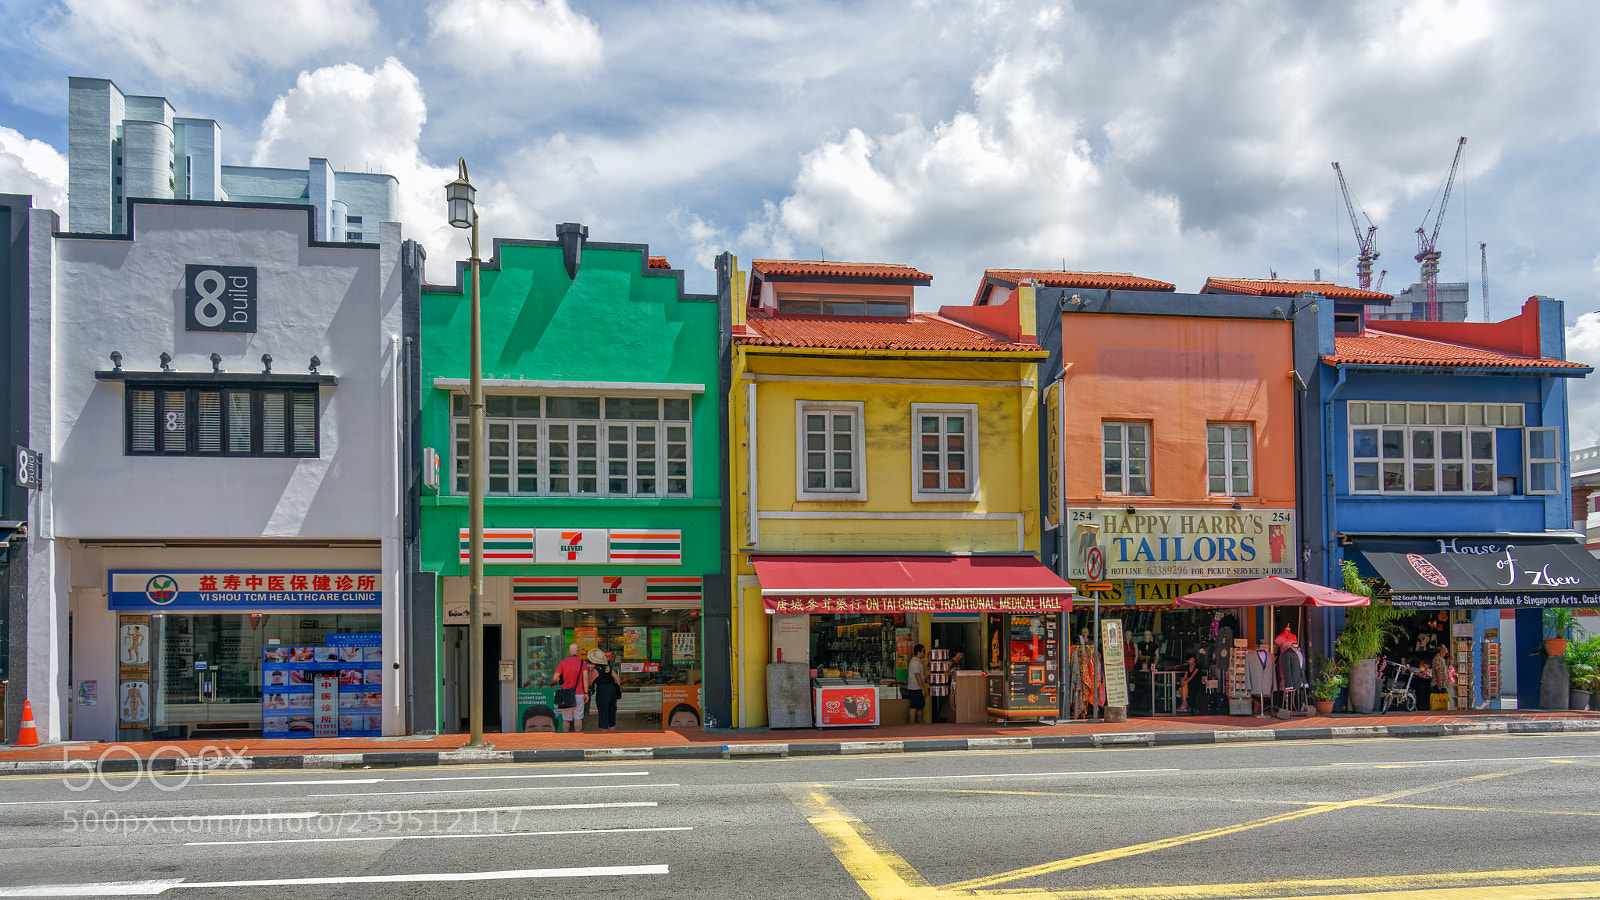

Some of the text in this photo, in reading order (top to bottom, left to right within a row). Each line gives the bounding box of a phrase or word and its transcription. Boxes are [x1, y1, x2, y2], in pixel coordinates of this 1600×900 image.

[195, 270, 248, 327] 8 build
[20, 450, 28, 484] 8
[1049, 408, 1058, 515] TAILORS
[1073, 512, 1092, 521] 254
[1103, 514, 1263, 535] HAPPY HARRY'S
[1272, 512, 1290, 522] 254
[561, 532, 582, 560] 7
[1113, 536, 1256, 562] TAILORS
[1436, 538, 1500, 555] House
[1111, 567, 1142, 575] HOTLINE
[1147, 566, 1188, 575] 63389296
[1191, 567, 1204, 575] FOR
[1207, 567, 1231, 575] PICKUP
[1233, 567, 1259, 575] SERVICE
[1262, 567, 1269, 575] 24
[1271, 567, 1293, 575] HOURS
[1496, 545, 1518, 586] of
[1524, 563, 1582, 587] Zhen
[200, 575, 376, 591] 益寿中医保健诊所
[603, 577, 622, 602] 7
[200, 593, 376, 601] YI SHOU TCM HEALTHCARE CLINIC
[866, 596, 1062, 611] ON TAI GINSENG TRADITIONAL MEDICAL HALL
[1454, 595, 1492, 605] Handmade
[1493, 596, 1515, 605] Asian
[1516, 596, 1523, 605] &
[1523, 595, 1560, 606] Singapore
[321, 681, 332, 724] 中医诊所
